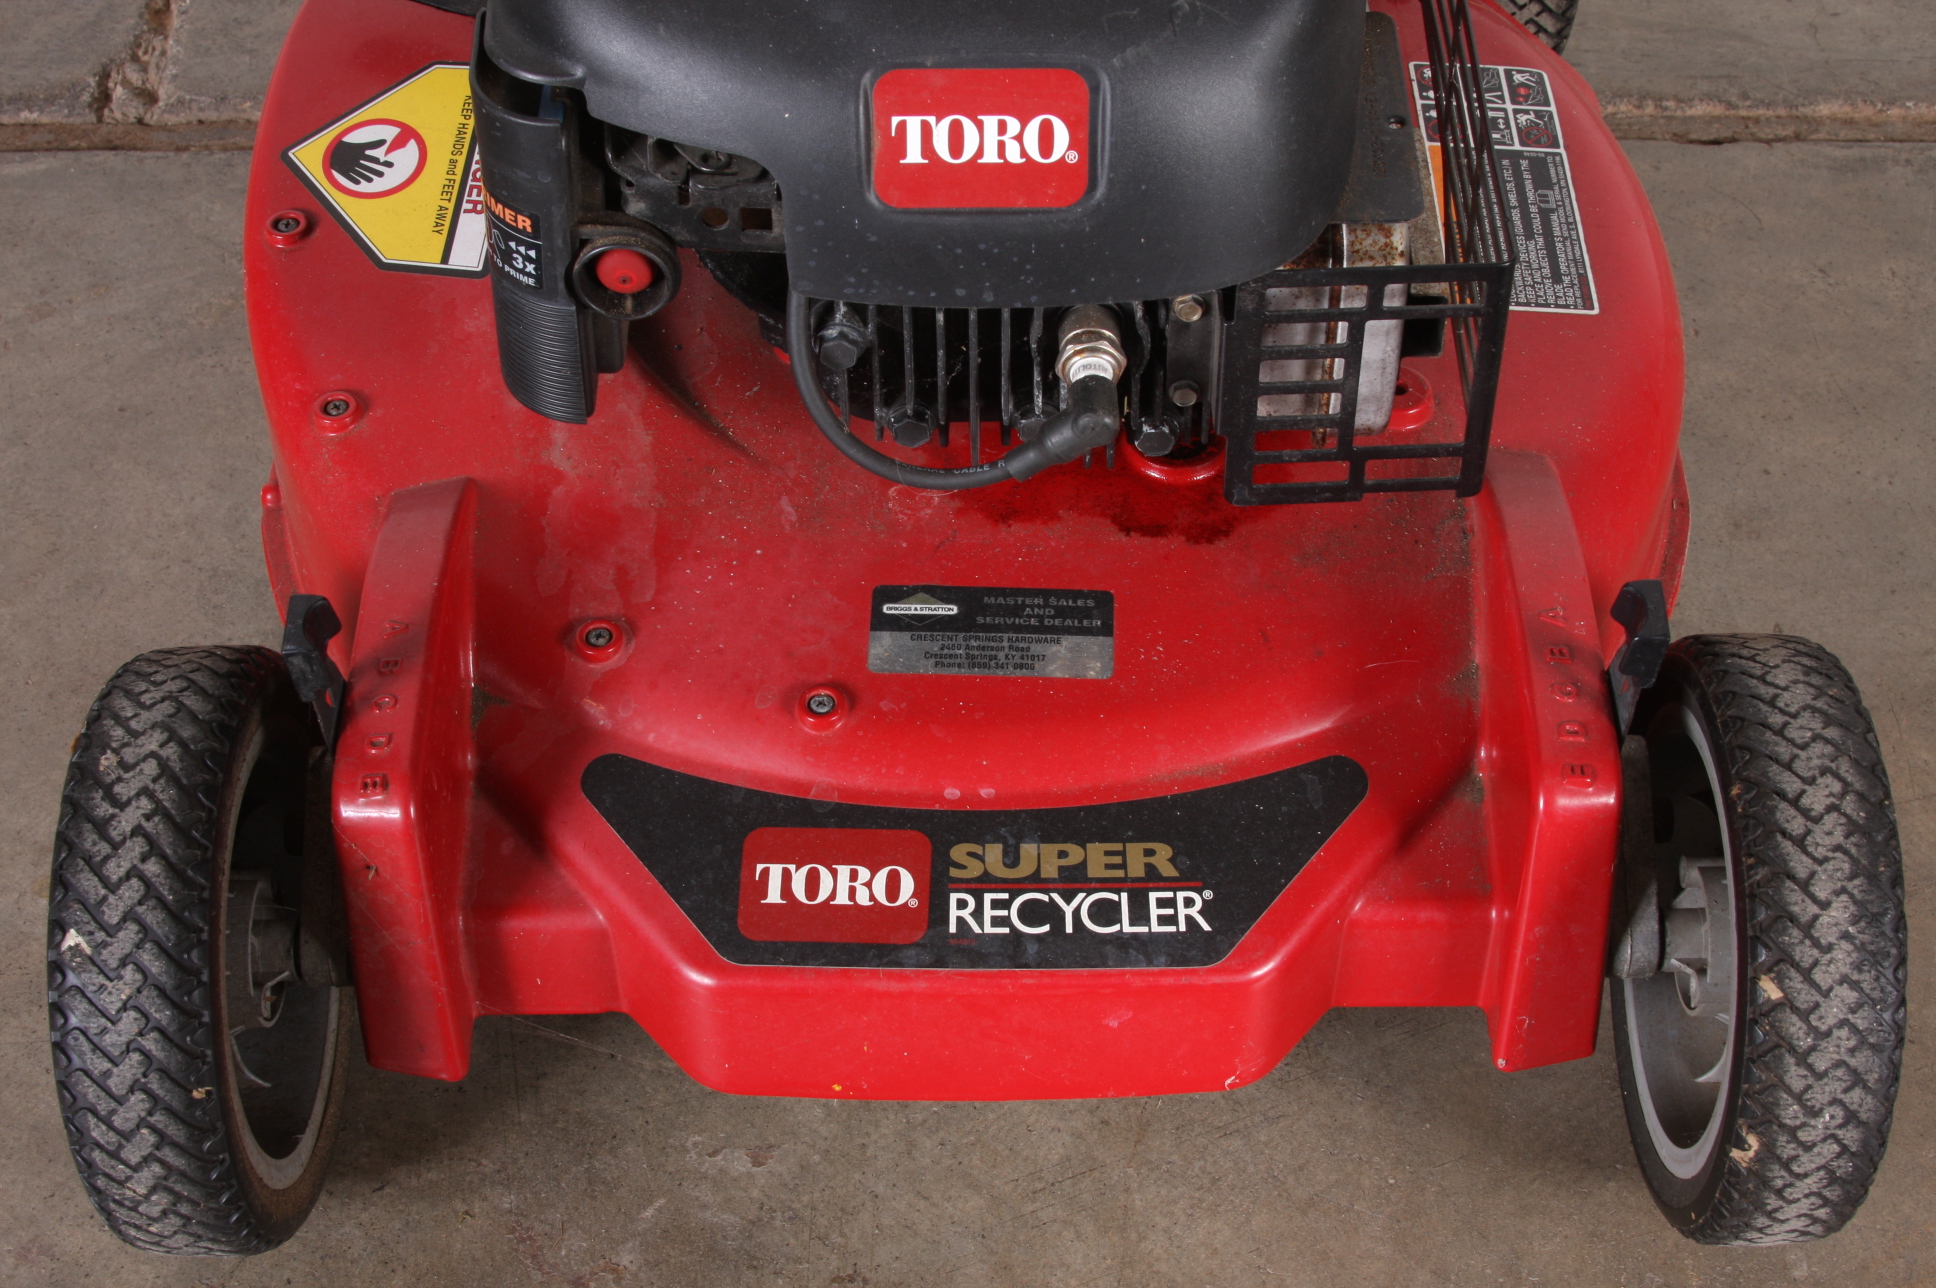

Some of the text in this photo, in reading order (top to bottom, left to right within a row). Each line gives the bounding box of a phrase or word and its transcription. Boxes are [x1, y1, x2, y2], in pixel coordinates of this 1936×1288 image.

[451, 122, 470, 157] HANDS
[446, 158, 459, 176] and
[1520, 160, 1529, 170] THE
[1548, 163, 1557, 183] NUMBER
[440, 178, 456, 203] FEET
[1524, 180, 1536, 203] THROWN
[1553, 184, 1561, 200] SERIAL
[1529, 204, 1538, 212] BE
[1558, 206, 1566, 222] MODEL
[431, 204, 449, 236] AWAY
[1531, 213, 1542, 233] COULD
[1561, 224, 1570, 237] SEND
[1516, 236, 1528, 261] DEVICES
[1535, 234, 1545, 249] THAT
[1554, 237, 1569, 274] OPERATOR'S
[1572, 240, 1582, 261] LYNDALE
[1538, 250, 1551, 277] OBJECTS
[504, 263, 537, 287] PRIME
[1521, 262, 1533, 285] SAFETY
[1532, 270, 1542, 282] AND
[1562, 275, 1572, 287] THE
[1569, 260, 1581, 297] REPLACEMENT
[1526, 287, 1536, 302] KEEP
[1535, 284, 1546, 303] PLACE
[1543, 279, 1556, 303] REMOVE
[1565, 288, 1576, 304] READ
[1576, 298, 1584, 309] FOR
[983, 596, 1096, 607] MASTER SALES
[1023, 607, 1055, 616] AND
[976, 616, 1102, 627] SERVICE DEALER
[910, 633, 1062, 645] CRESCENT SPRINGS HARDWARE
[924, 652, 962, 660] Crescent
[1004, 653, 1016, 661] KY
[1019, 654, 1046, 662] 41017
[965, 644, 1006, 652] Anderson
[1008, 645, 1031, 653] Road
[948, 842, 1180, 880] SUPER
